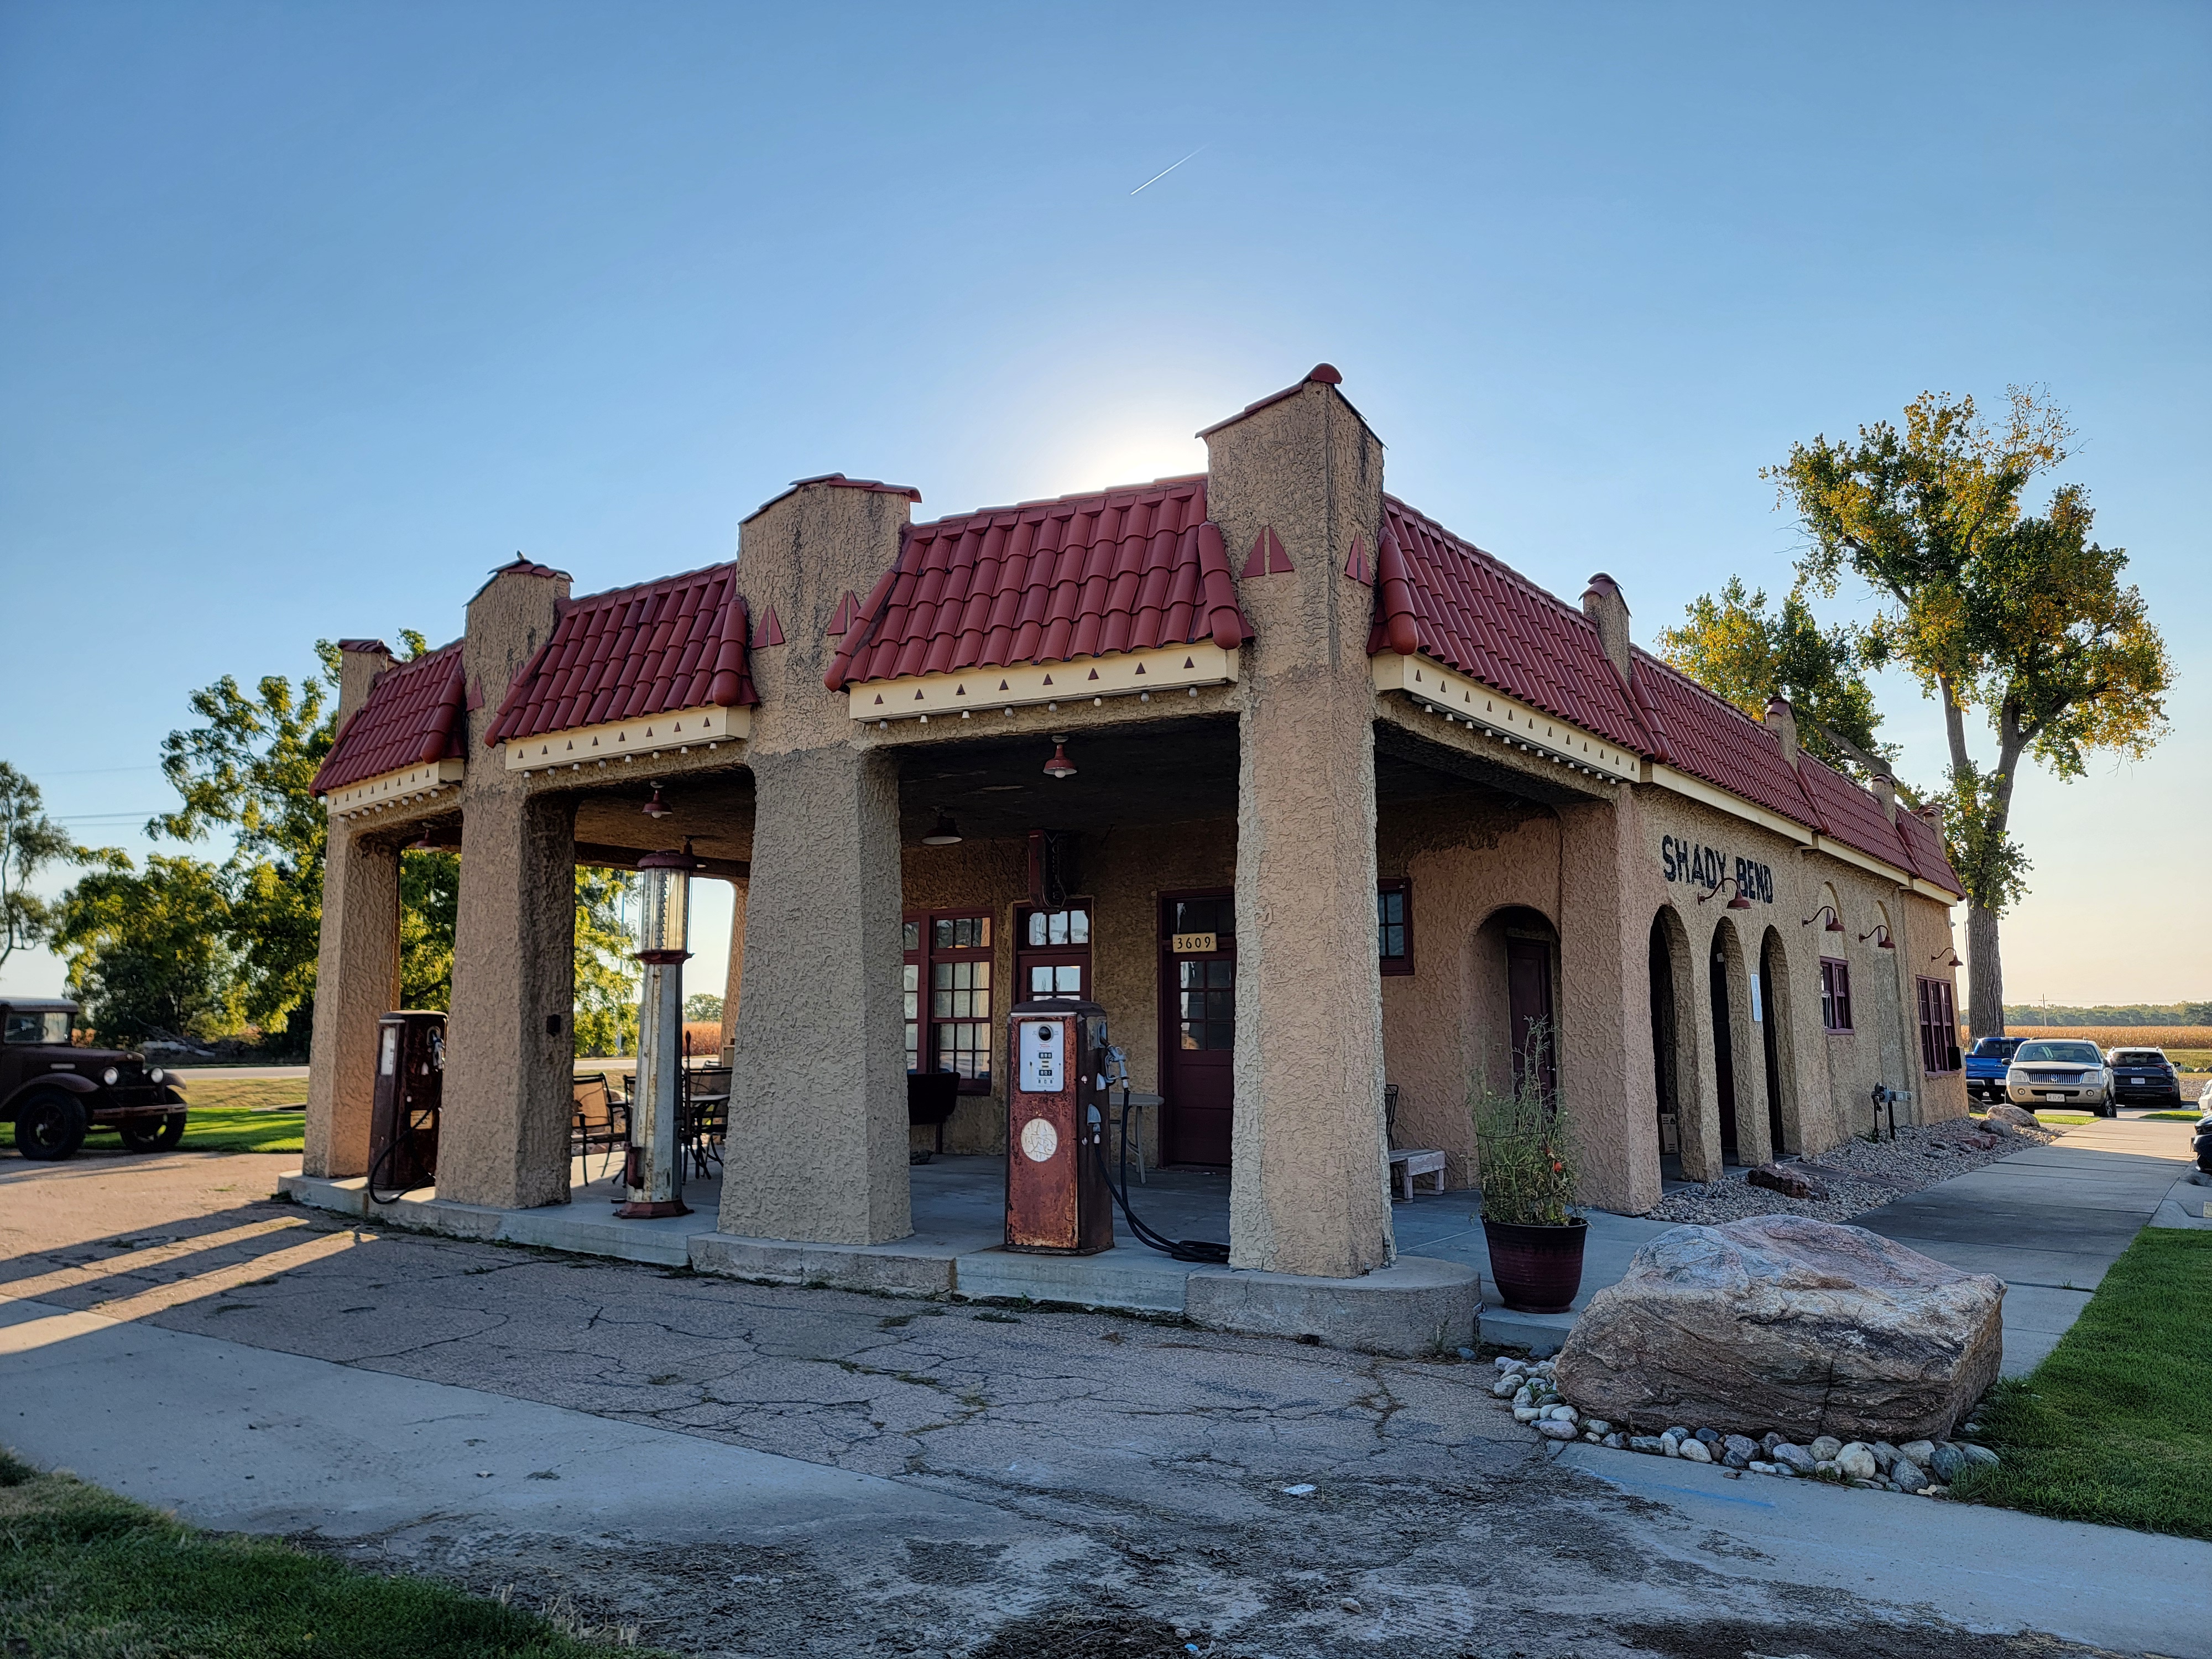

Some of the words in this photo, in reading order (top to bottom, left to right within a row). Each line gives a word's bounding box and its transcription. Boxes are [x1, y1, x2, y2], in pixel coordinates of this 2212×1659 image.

[1662, 834, 1726, 893] SHADY
[1735, 856, 1773, 904] BEND
[1177, 936, 1211, 949] 3609
